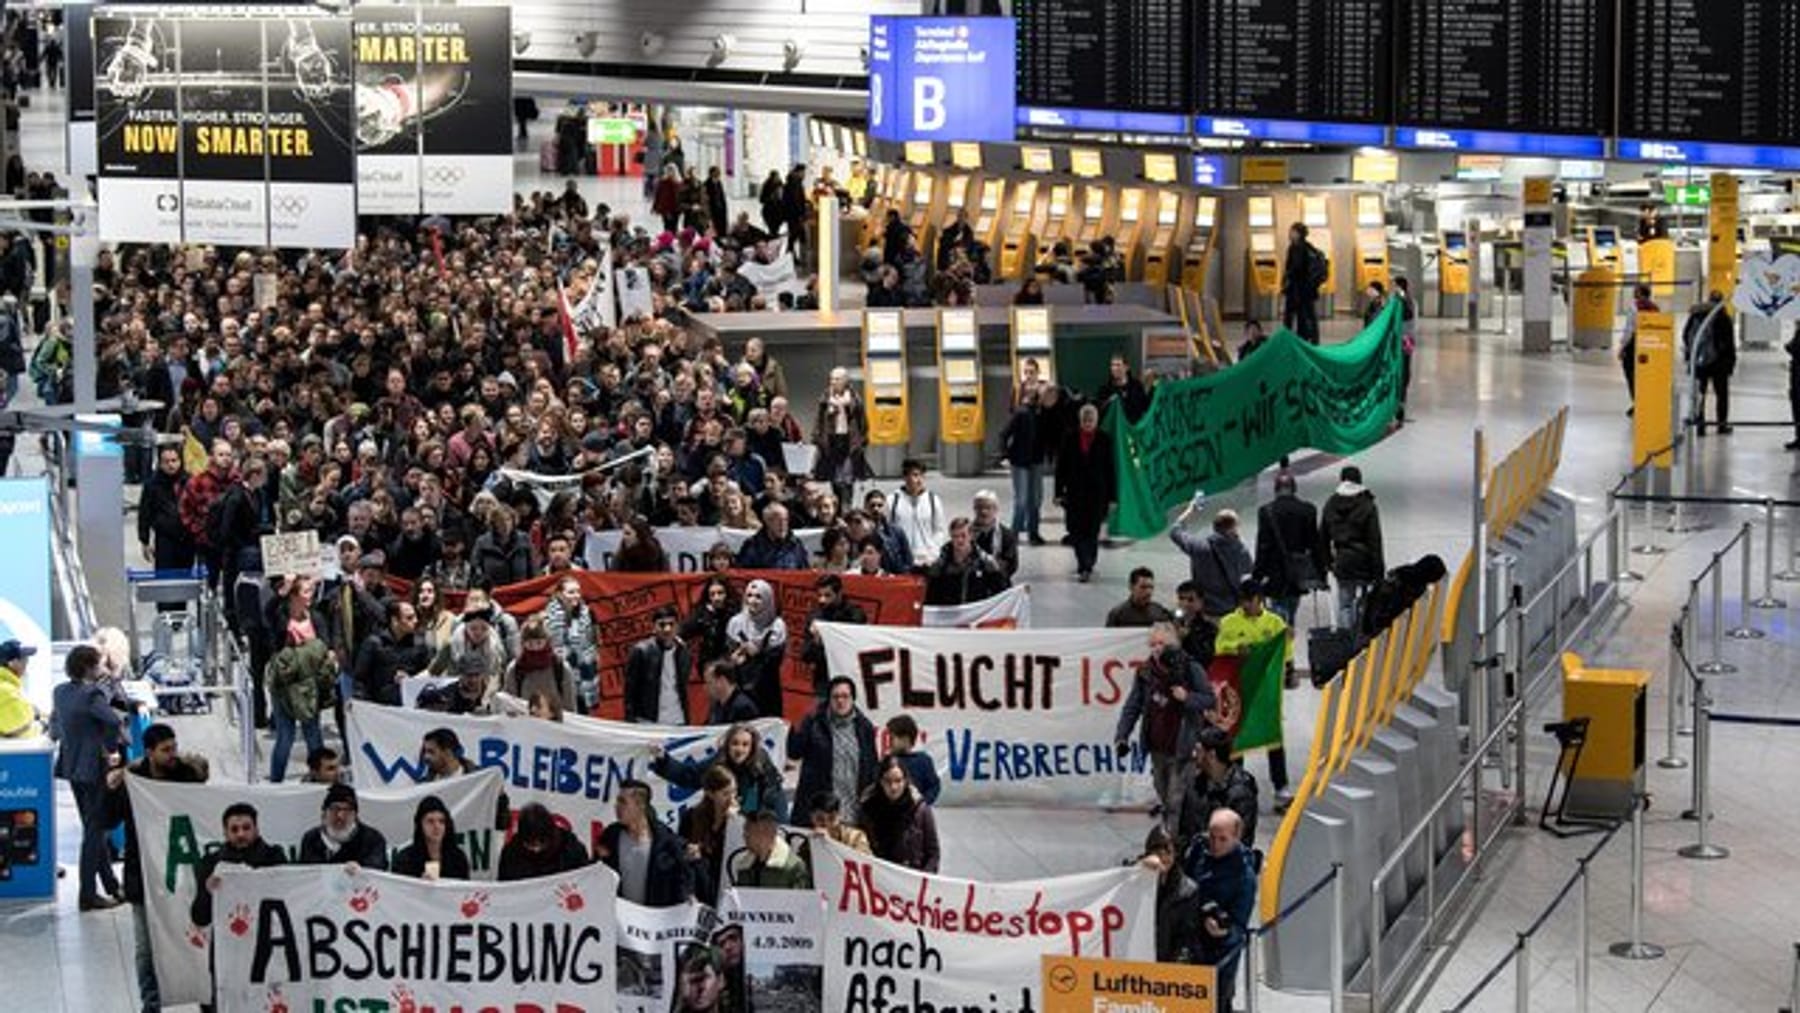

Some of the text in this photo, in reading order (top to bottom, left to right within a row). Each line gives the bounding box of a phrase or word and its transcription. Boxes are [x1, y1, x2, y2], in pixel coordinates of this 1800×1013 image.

[355, 36, 470, 63] MARTER.
[128, 110, 306, 125] FASTER. HIGHER. STRONGER.
[913, 77, 946, 131] B
[123, 125, 313, 156] NOW SMARTER.
[858, 648, 1060, 711] FLUCHT
[479, 738, 633, 803] BLEIBEN
[838, 859, 1125, 957] Abschiebestopp
[250, 898, 605, 985] ABSCHIEBUNG
[844, 928, 942, 972] nach
[1093, 972, 1209, 999] Lufthansa
